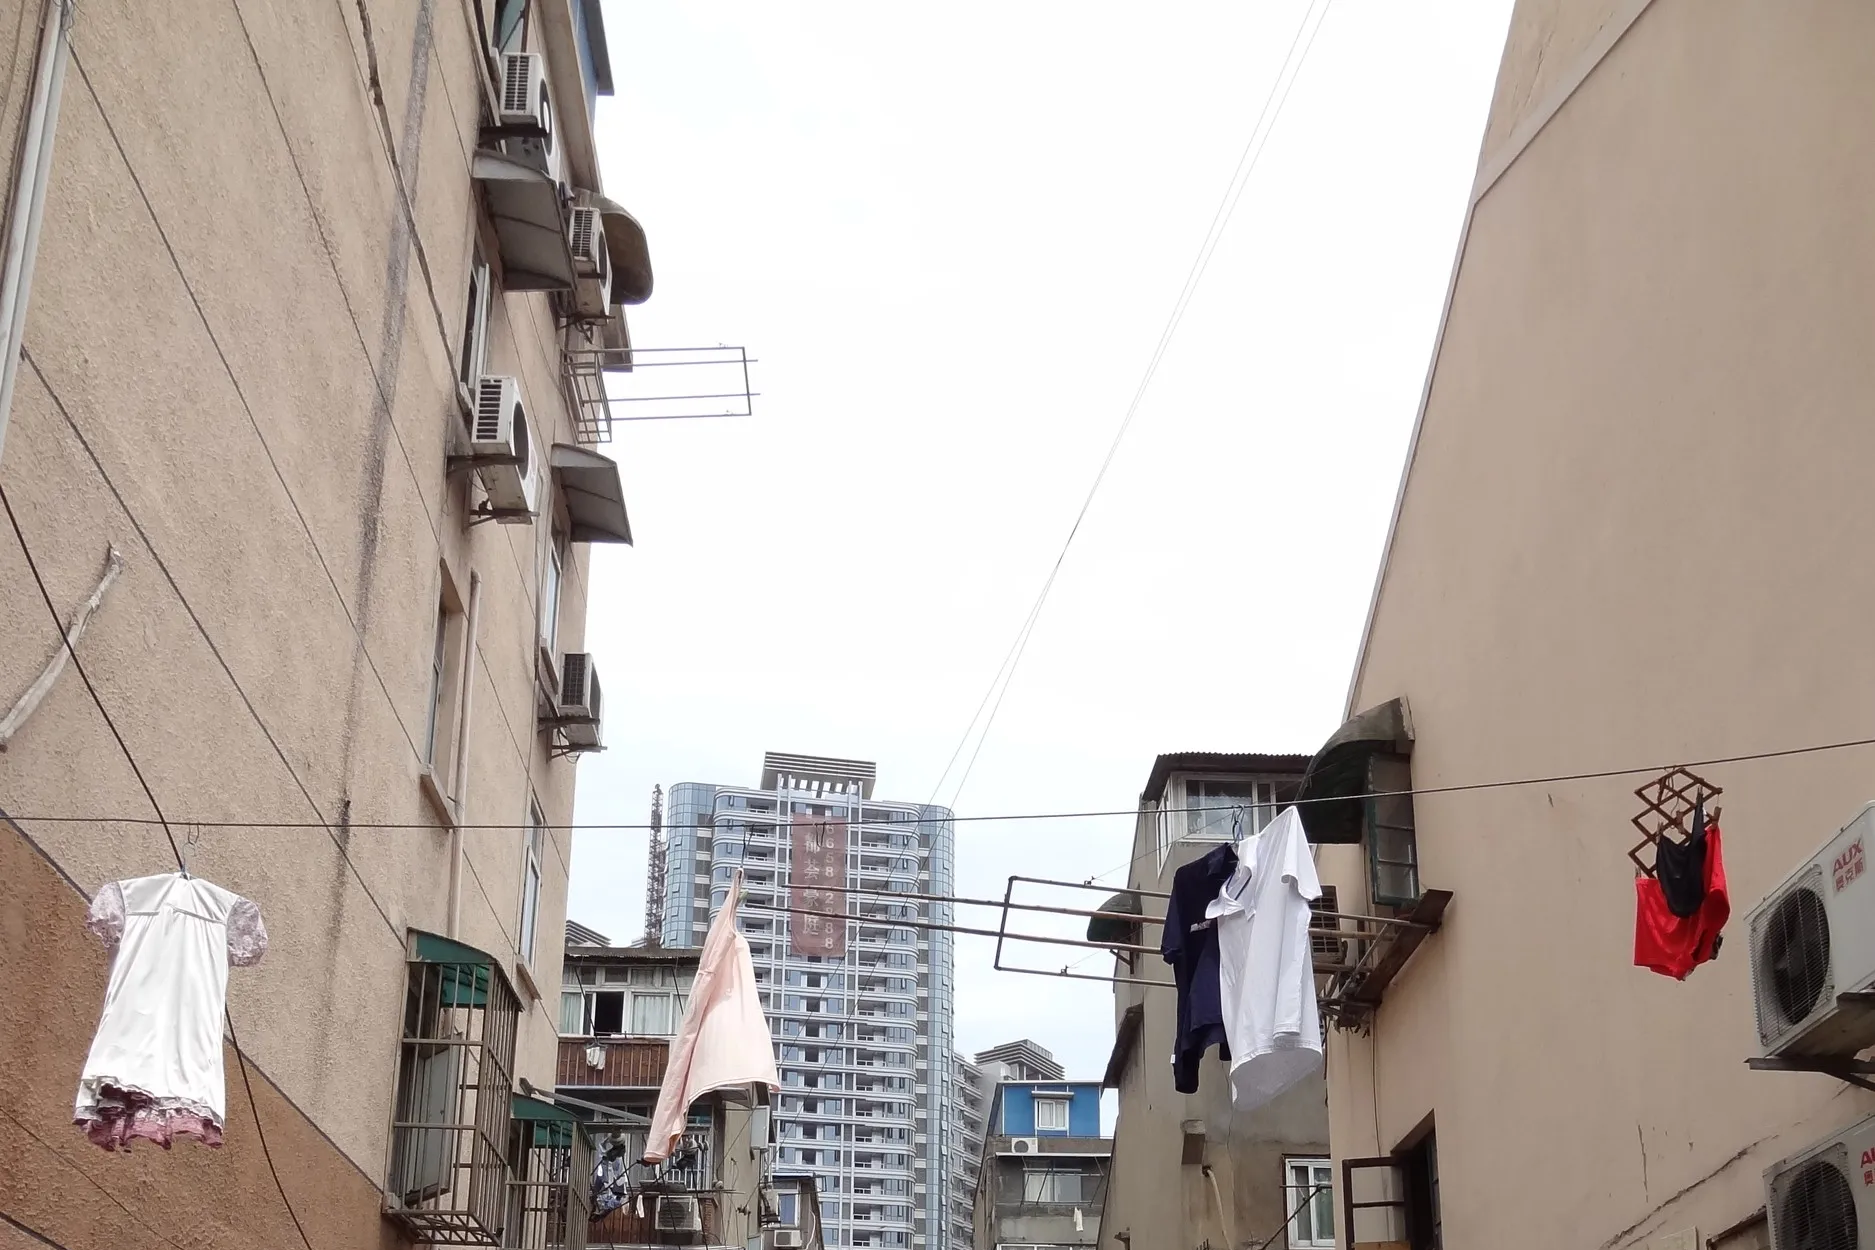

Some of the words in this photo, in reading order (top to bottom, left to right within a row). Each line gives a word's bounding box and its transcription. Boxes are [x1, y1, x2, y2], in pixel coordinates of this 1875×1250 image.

[1832, 837, 1863, 876] AUX
[1835, 857, 1864, 892] 奥克斯
